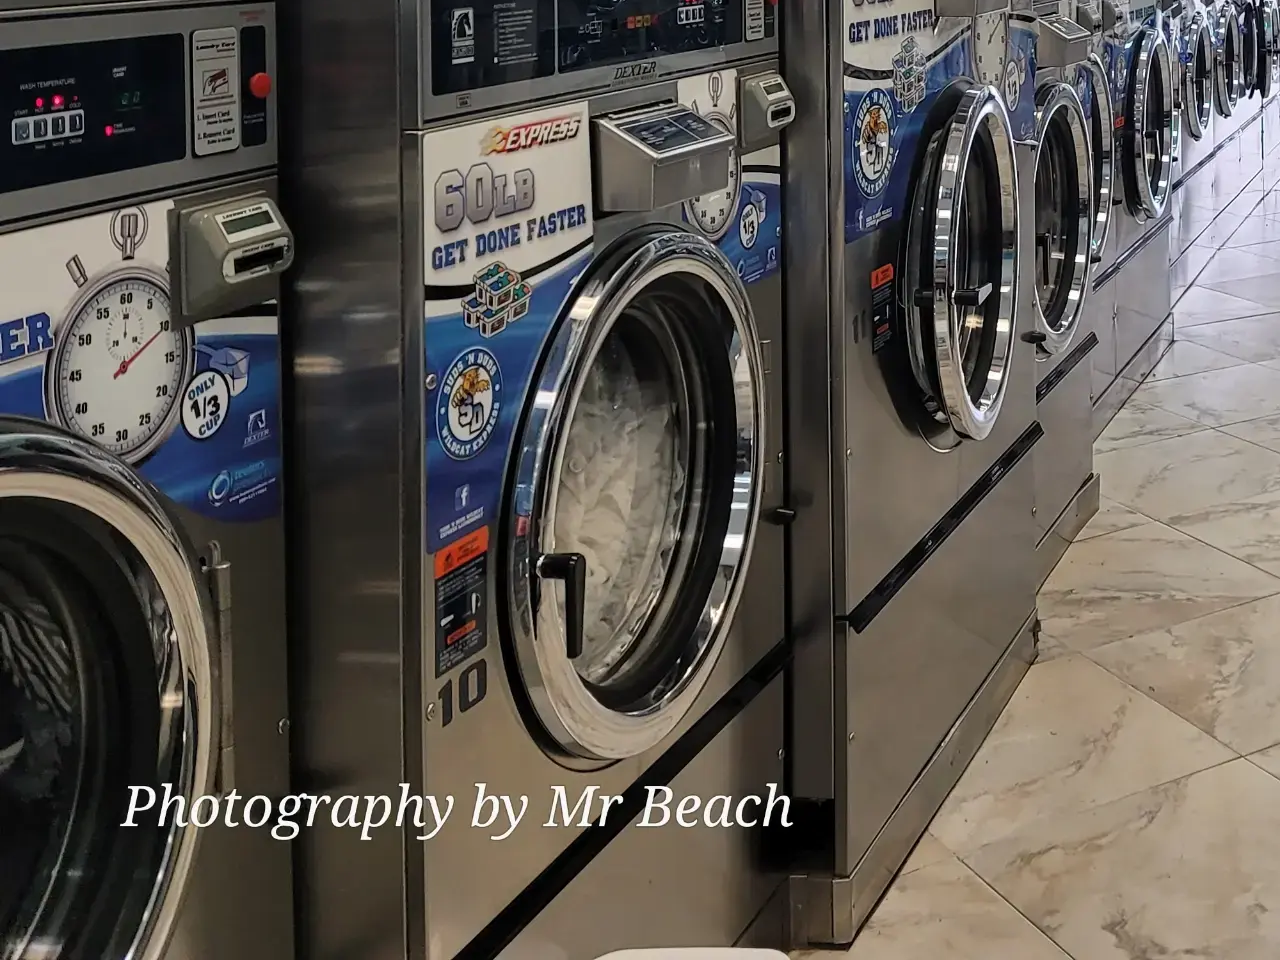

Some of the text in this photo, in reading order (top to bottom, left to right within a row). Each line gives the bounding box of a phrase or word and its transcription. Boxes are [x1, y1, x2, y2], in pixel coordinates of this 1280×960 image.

[849, 9, 934, 43] GET DONE FASTER
[613, 61, 657, 80] DEXTER
[20, 78, 76, 91] WASH TEMPERATURE
[505, 117, 581, 151] EXPRESS
[434, 161, 535, 234] 60LB
[743, 220, 755, 235] 1/3
[432, 204, 587, 271] GET DONE FASTER
[120, 292, 132, 304] 60
[147, 299, 153, 309] 5
[96, 307, 110, 319] 55
[160, 320, 169, 331] 10
[78, 333, 92, 346] 50
[165, 351, 175, 363] 15
[69, 369, 82, 382] 45
[444, 360, 463, 395] SUDS
[477, 353, 497, 377] DUDS
[156, 385, 167, 398] 20
[188, 375, 216, 401] ONLY
[75, 402, 88, 415] 40
[190, 394, 221, 420] 1/3
[139, 413, 151, 426] 25
[198, 414, 221, 436] CUP
[92, 423, 104, 437] 35
[116, 429, 128, 442] 30
[441, 402, 499, 456] WILDCAT EXPRESS
[244, 429, 270, 445] DEXTER
[438, 658, 487, 728] 10
